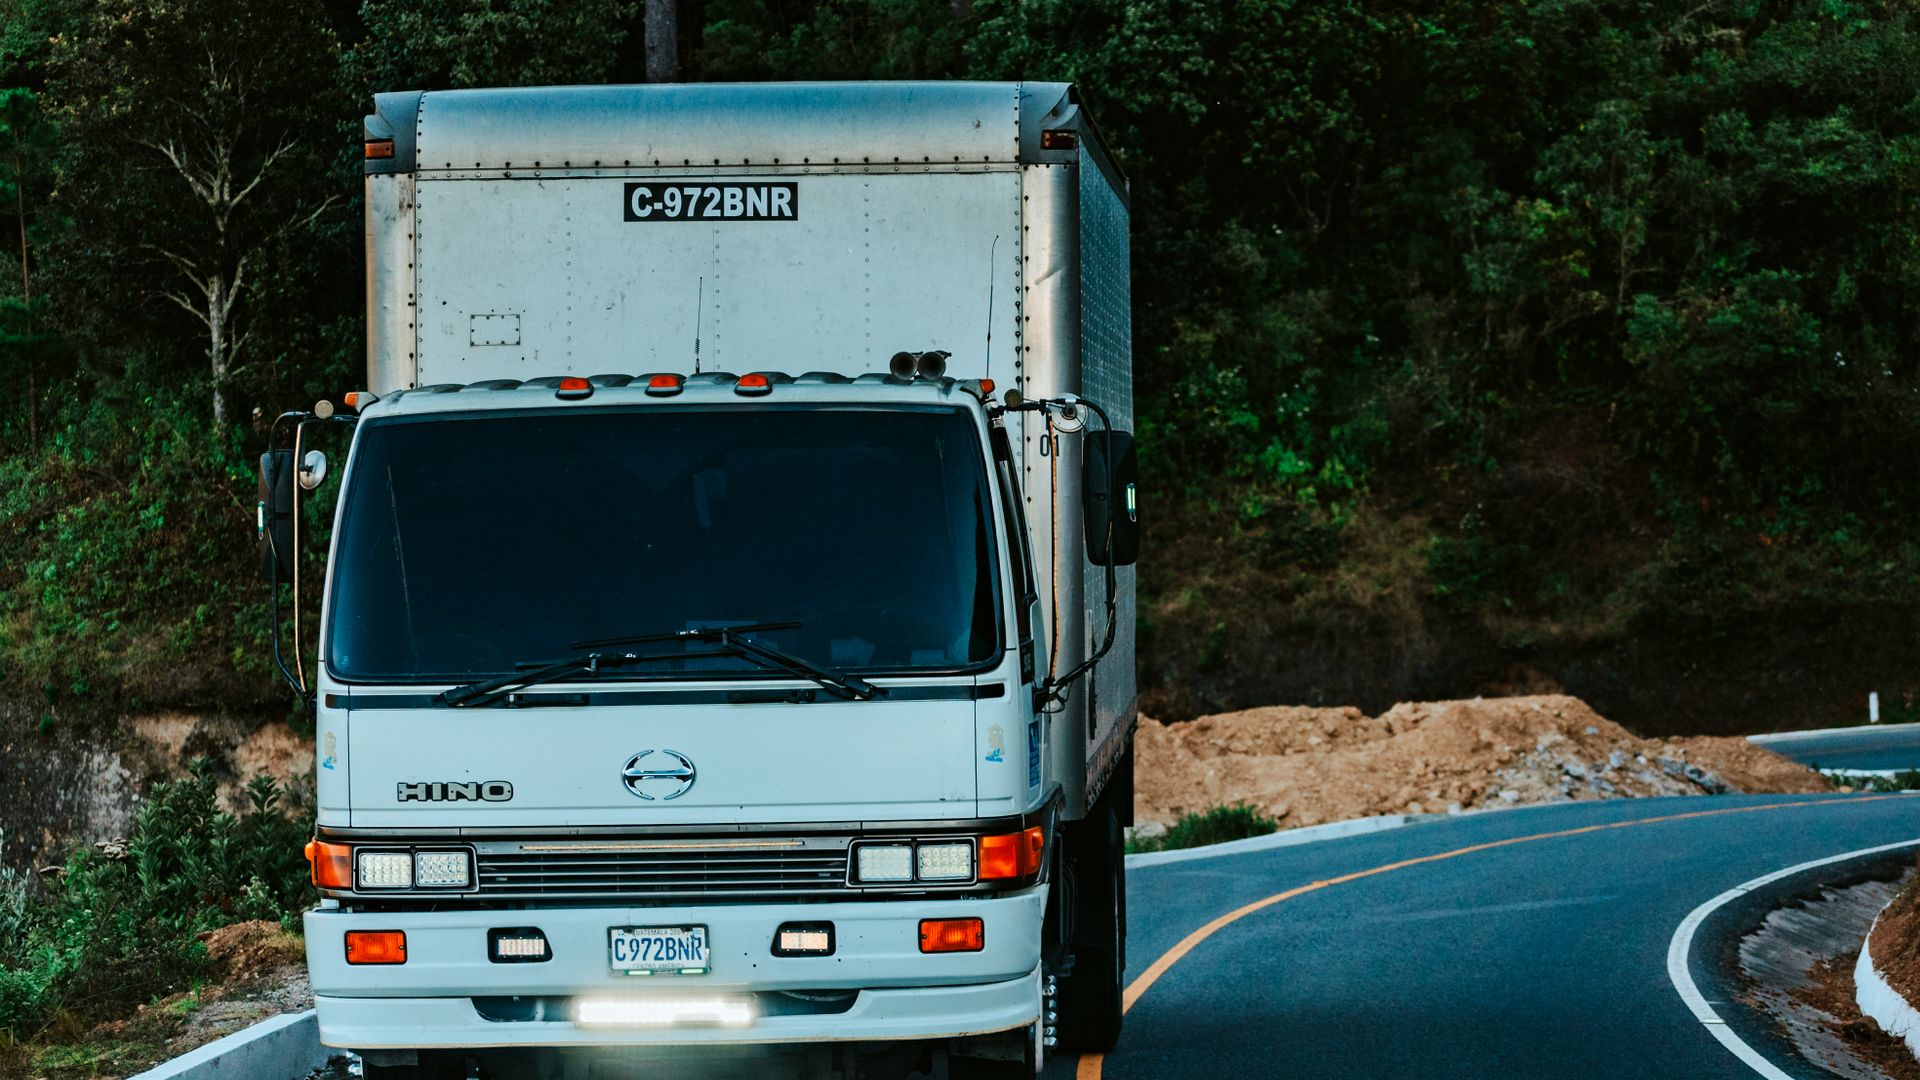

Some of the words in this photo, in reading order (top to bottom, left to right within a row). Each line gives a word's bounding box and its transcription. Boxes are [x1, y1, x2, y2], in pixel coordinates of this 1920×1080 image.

[632, 187, 792, 217] C-972BNR
[1040, 434, 1059, 457] 01
[397, 781, 513, 802] HINO
